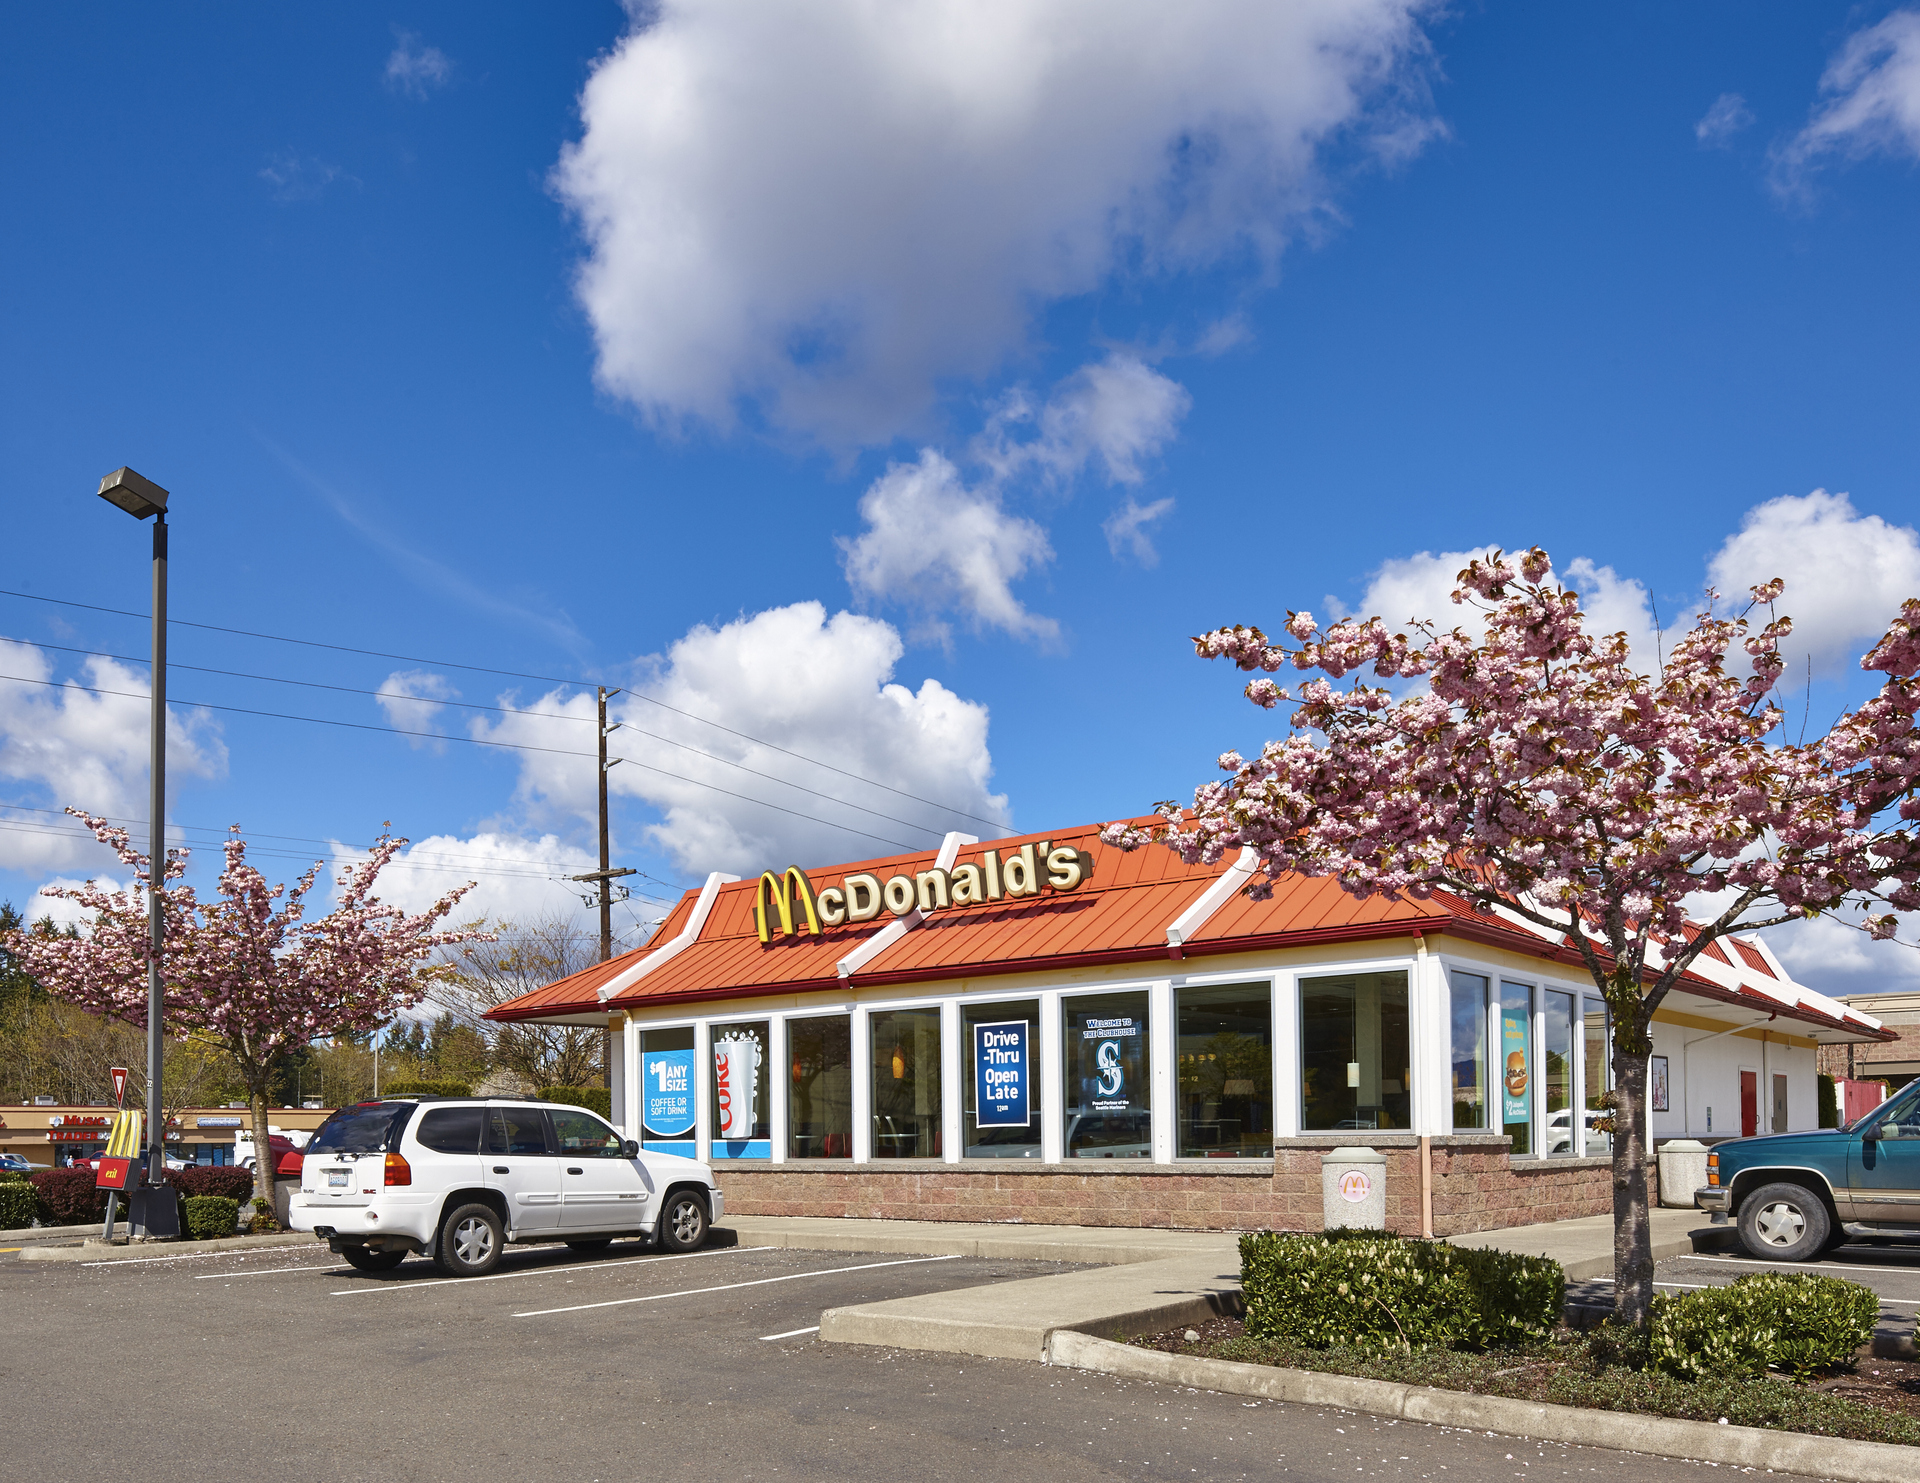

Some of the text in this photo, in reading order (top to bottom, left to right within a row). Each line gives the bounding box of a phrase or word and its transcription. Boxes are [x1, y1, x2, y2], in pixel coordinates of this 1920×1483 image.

[757, 839, 1088, 944] McDonald's
[984, 1031, 1019, 1047] Drive
[983, 1049, 1020, 1064] -Thru
[650, 1060, 687, 1092] $1 ANY
[985, 1068, 1019, 1086] Open
[666, 1079, 688, 1092] SIZE
[986, 1085, 1019, 1100] Late
[650, 1097, 687, 1107] COFFEE OR
[650, 1107, 688, 1116] SOFT DRINK
[63, 1115, 106, 1126] MUSIC
[47, 1130, 99, 1141] TRADER
[105, 1168, 118, 1179] exit
